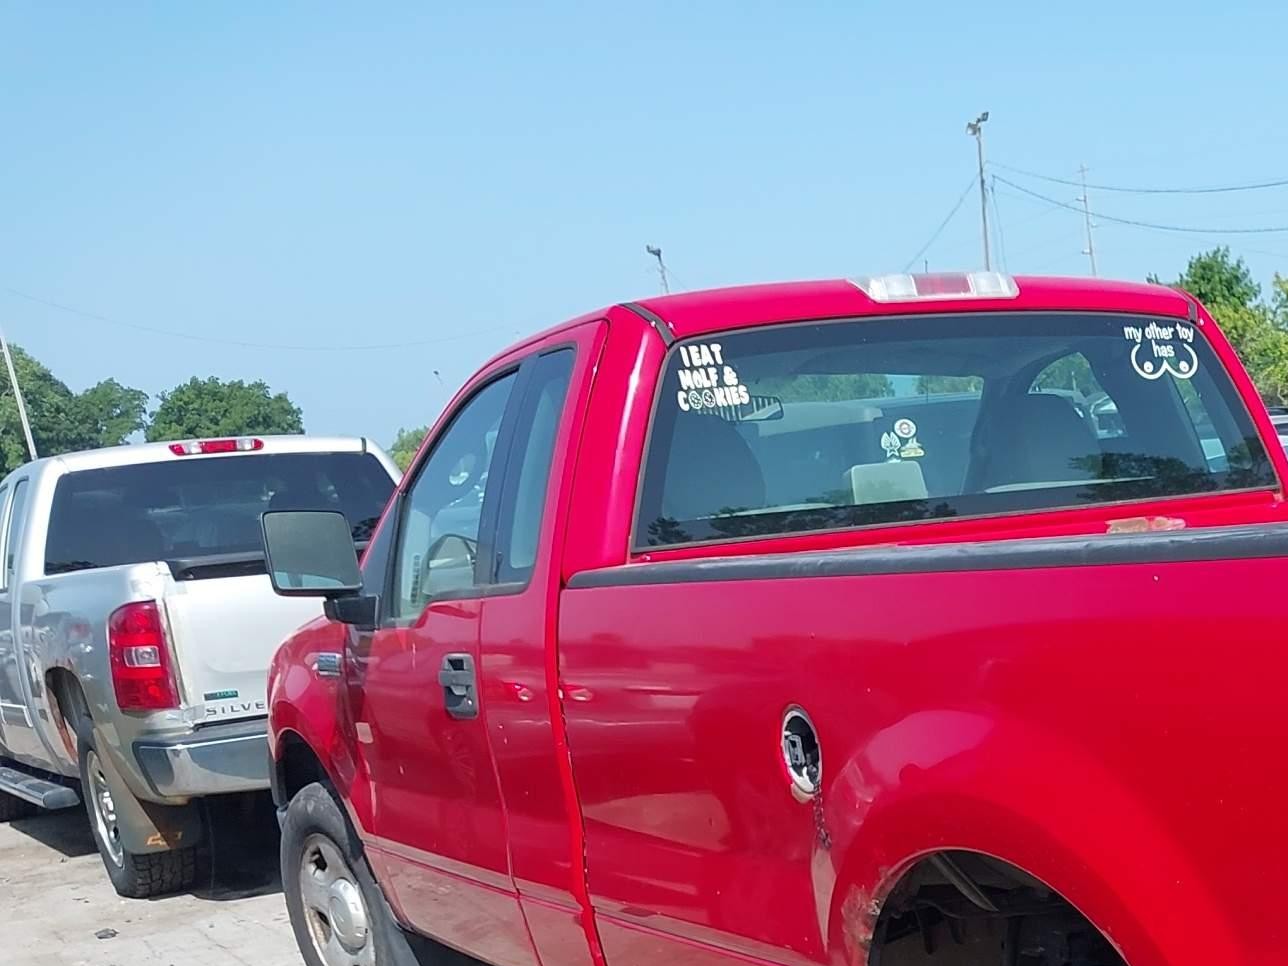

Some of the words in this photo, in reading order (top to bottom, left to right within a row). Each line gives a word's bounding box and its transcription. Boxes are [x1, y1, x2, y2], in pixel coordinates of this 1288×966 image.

[1123, 325, 1142, 343] my
[1144, 321, 1175, 340] other
[1175, 322, 1194, 343] toy
[679, 345, 690, 367] I
[688, 343, 723, 366] EAT
[1151, 339, 1175, 358] has
[723, 365, 738, 386] &
[677, 384, 750, 412] COOKIES
